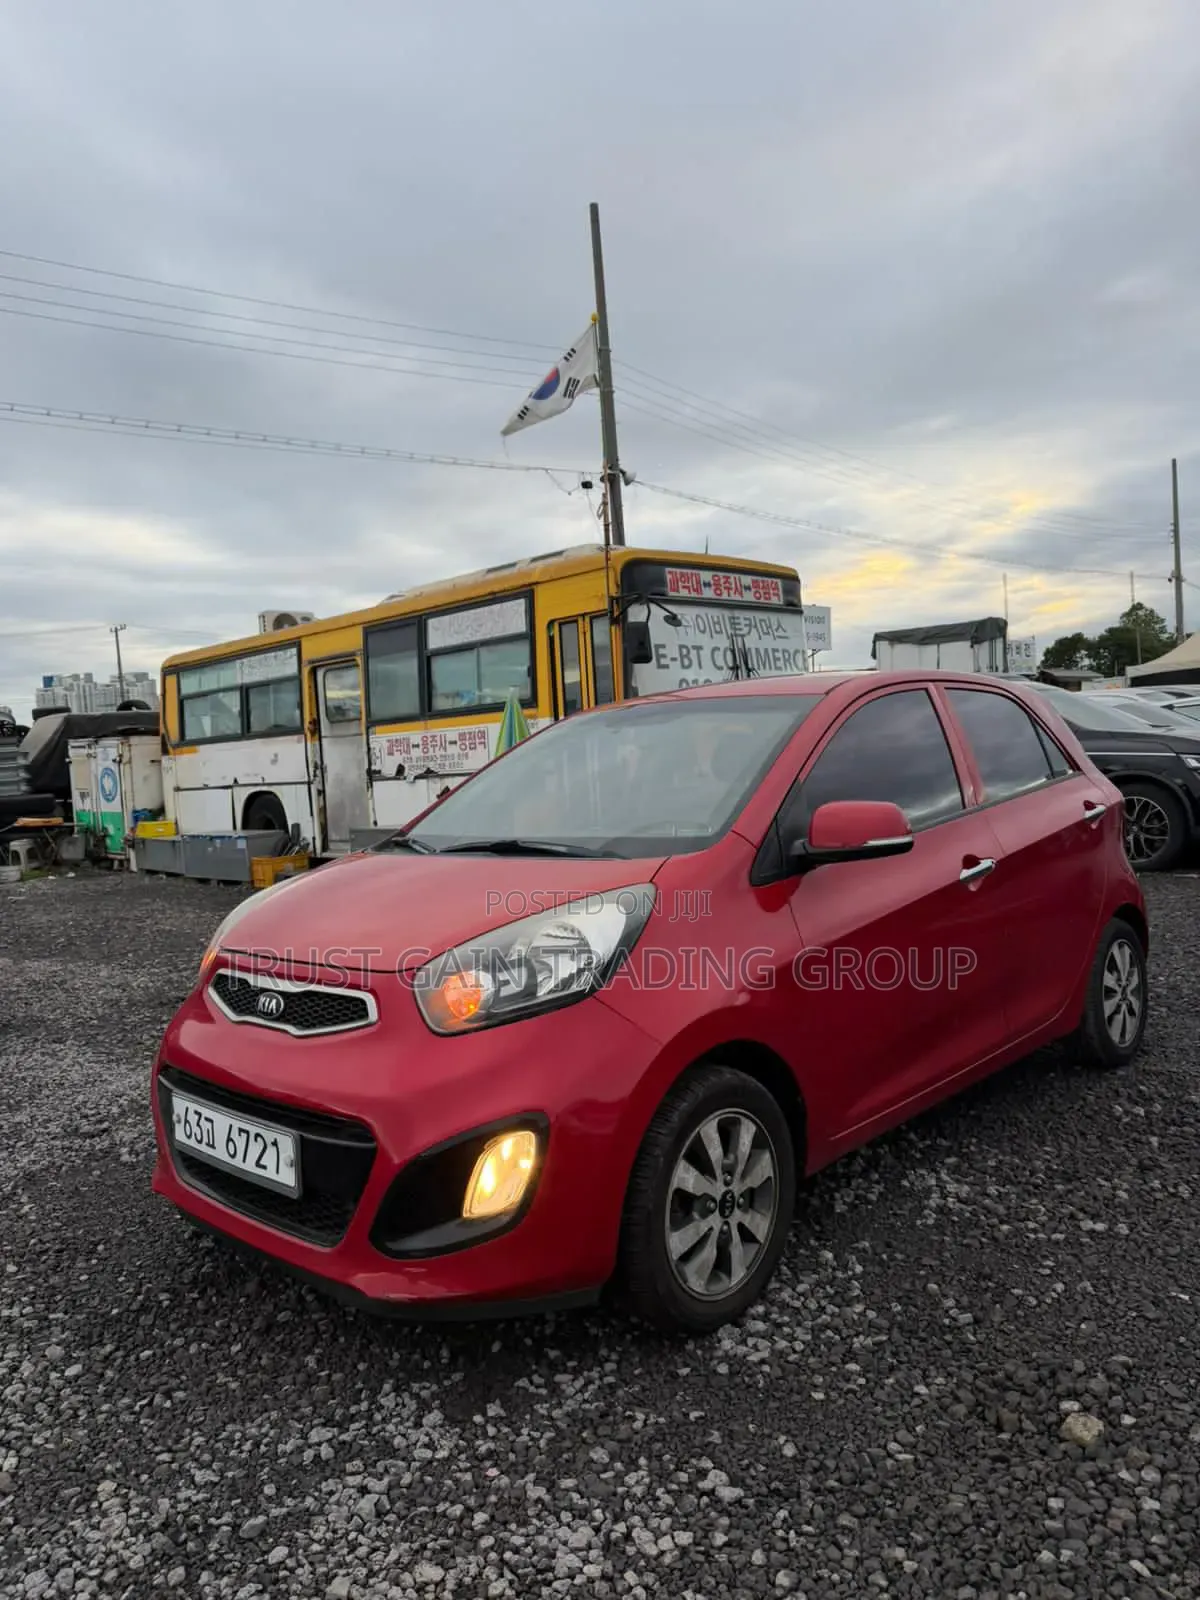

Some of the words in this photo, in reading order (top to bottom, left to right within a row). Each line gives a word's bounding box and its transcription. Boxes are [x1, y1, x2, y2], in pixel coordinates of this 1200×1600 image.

[654, 644, 704, 670] E-BT
[257, 996, 277, 1014] KIA
[225, 1123, 281, 1176] 6721
